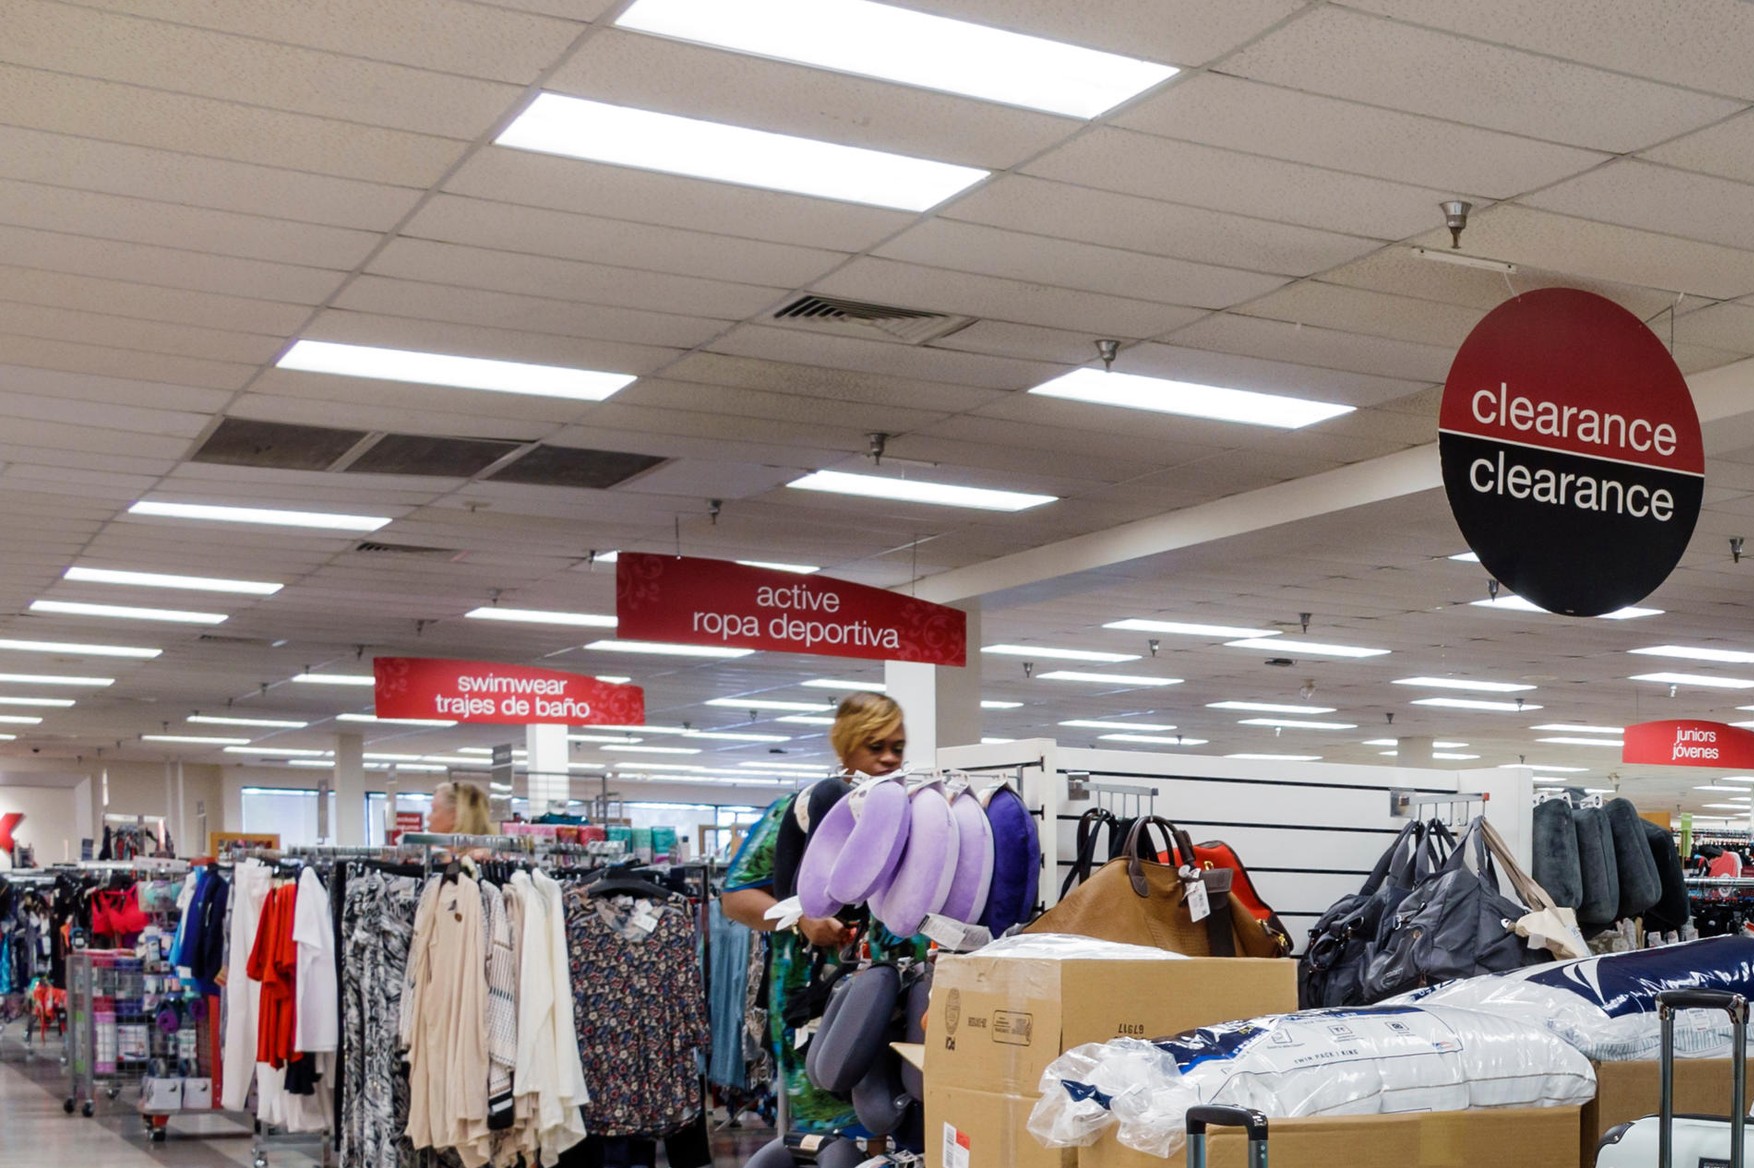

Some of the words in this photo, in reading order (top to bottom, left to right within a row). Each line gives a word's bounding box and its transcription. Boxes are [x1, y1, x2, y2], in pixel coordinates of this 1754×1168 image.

[1471, 381, 1678, 456] clearance
[1469, 450, 1675, 521] clearance
[756, 584, 840, 613] active
[693, 611, 760, 640] ropa
[768, 613, 900, 649] deportiva
[457, 673, 568, 694] swimwear
[435, 694, 495, 718] trajes
[500, 696, 530, 716] de
[535, 697, 591, 718] baño
[1675, 726, 1717, 744] juniors
[1672, 742, 1720, 761] jóvenes
[1118, 1023, 1144, 1035] 67917
[1315, 1052, 1333, 1061] PACK
